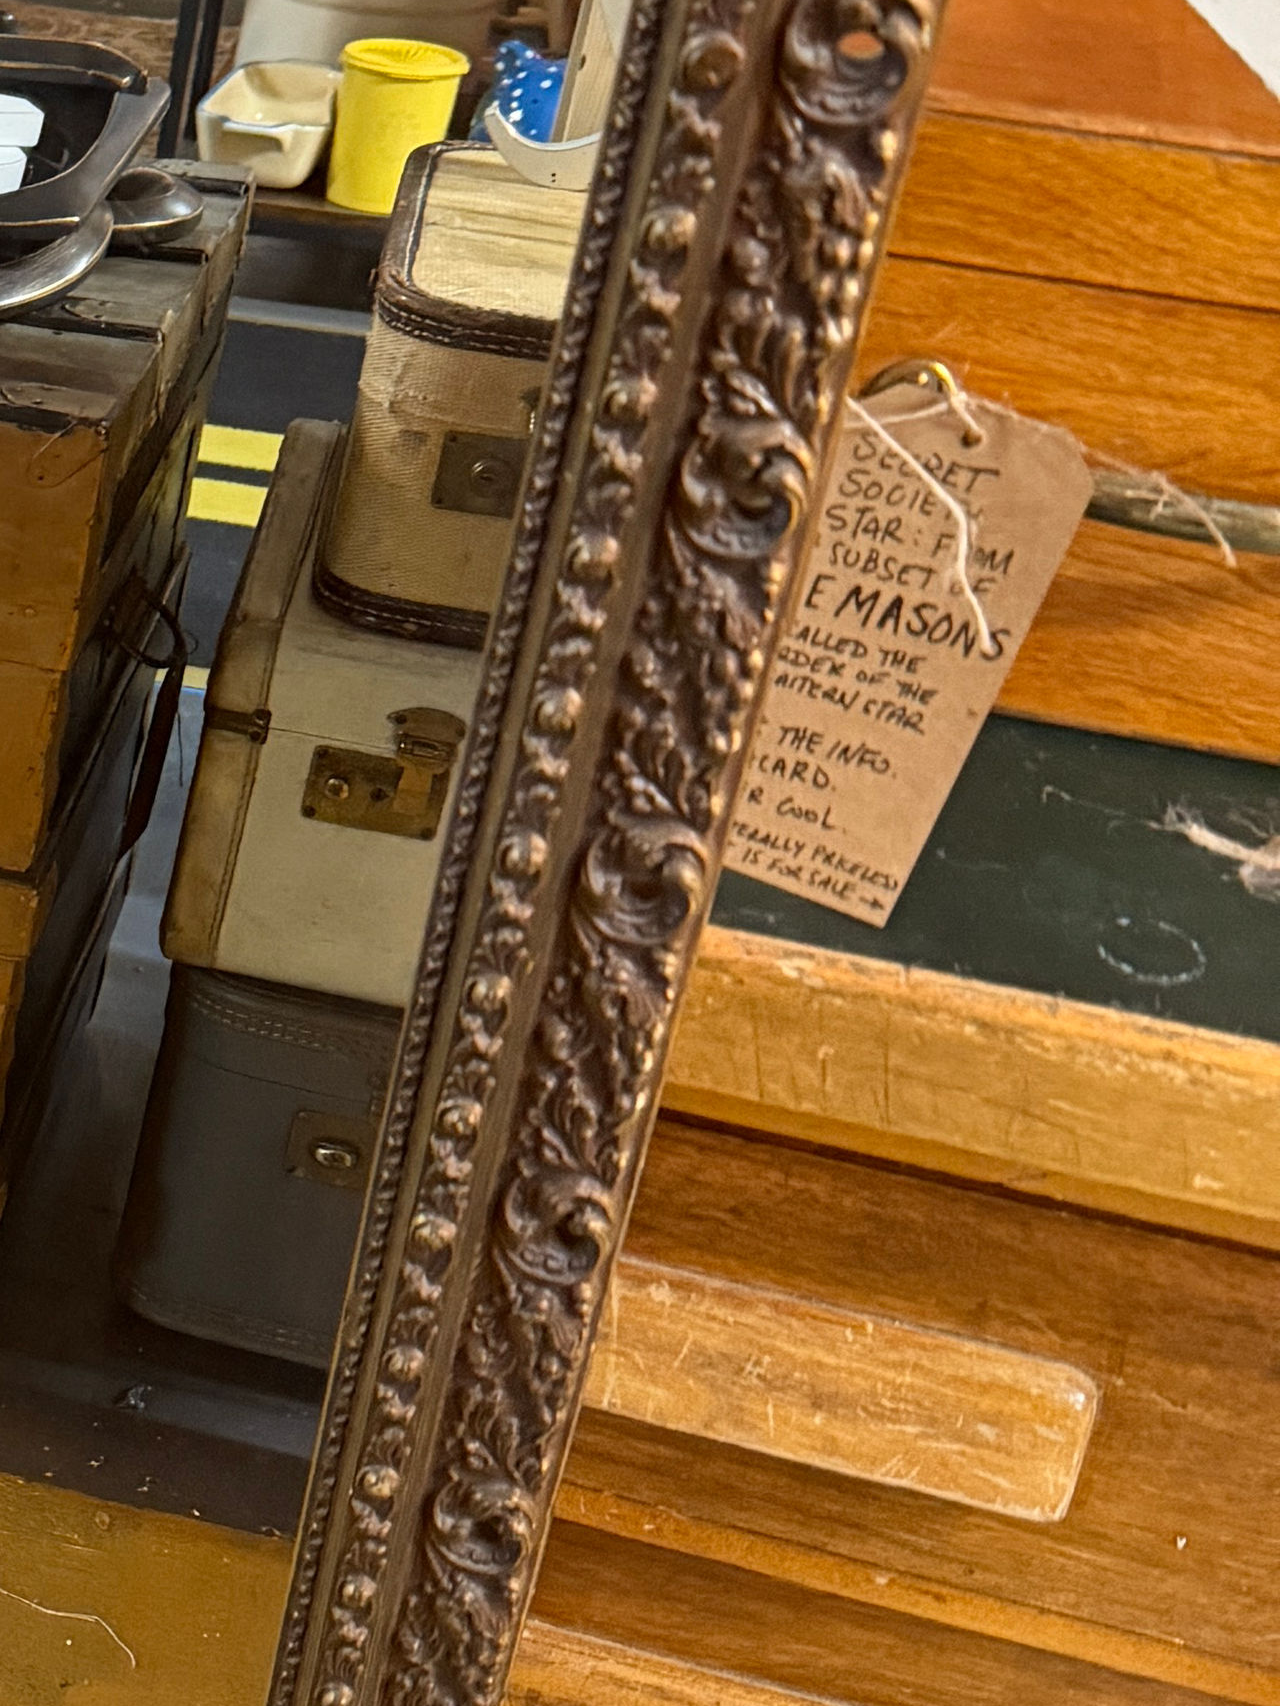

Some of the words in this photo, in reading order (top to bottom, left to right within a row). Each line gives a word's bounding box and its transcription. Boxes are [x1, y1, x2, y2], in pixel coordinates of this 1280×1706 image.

[828, 540, 934, 588] SUBSET
[836, 583, 1013, 663] MASONS
[876, 646, 930, 674] THE
[778, 723, 823, 755] THE
